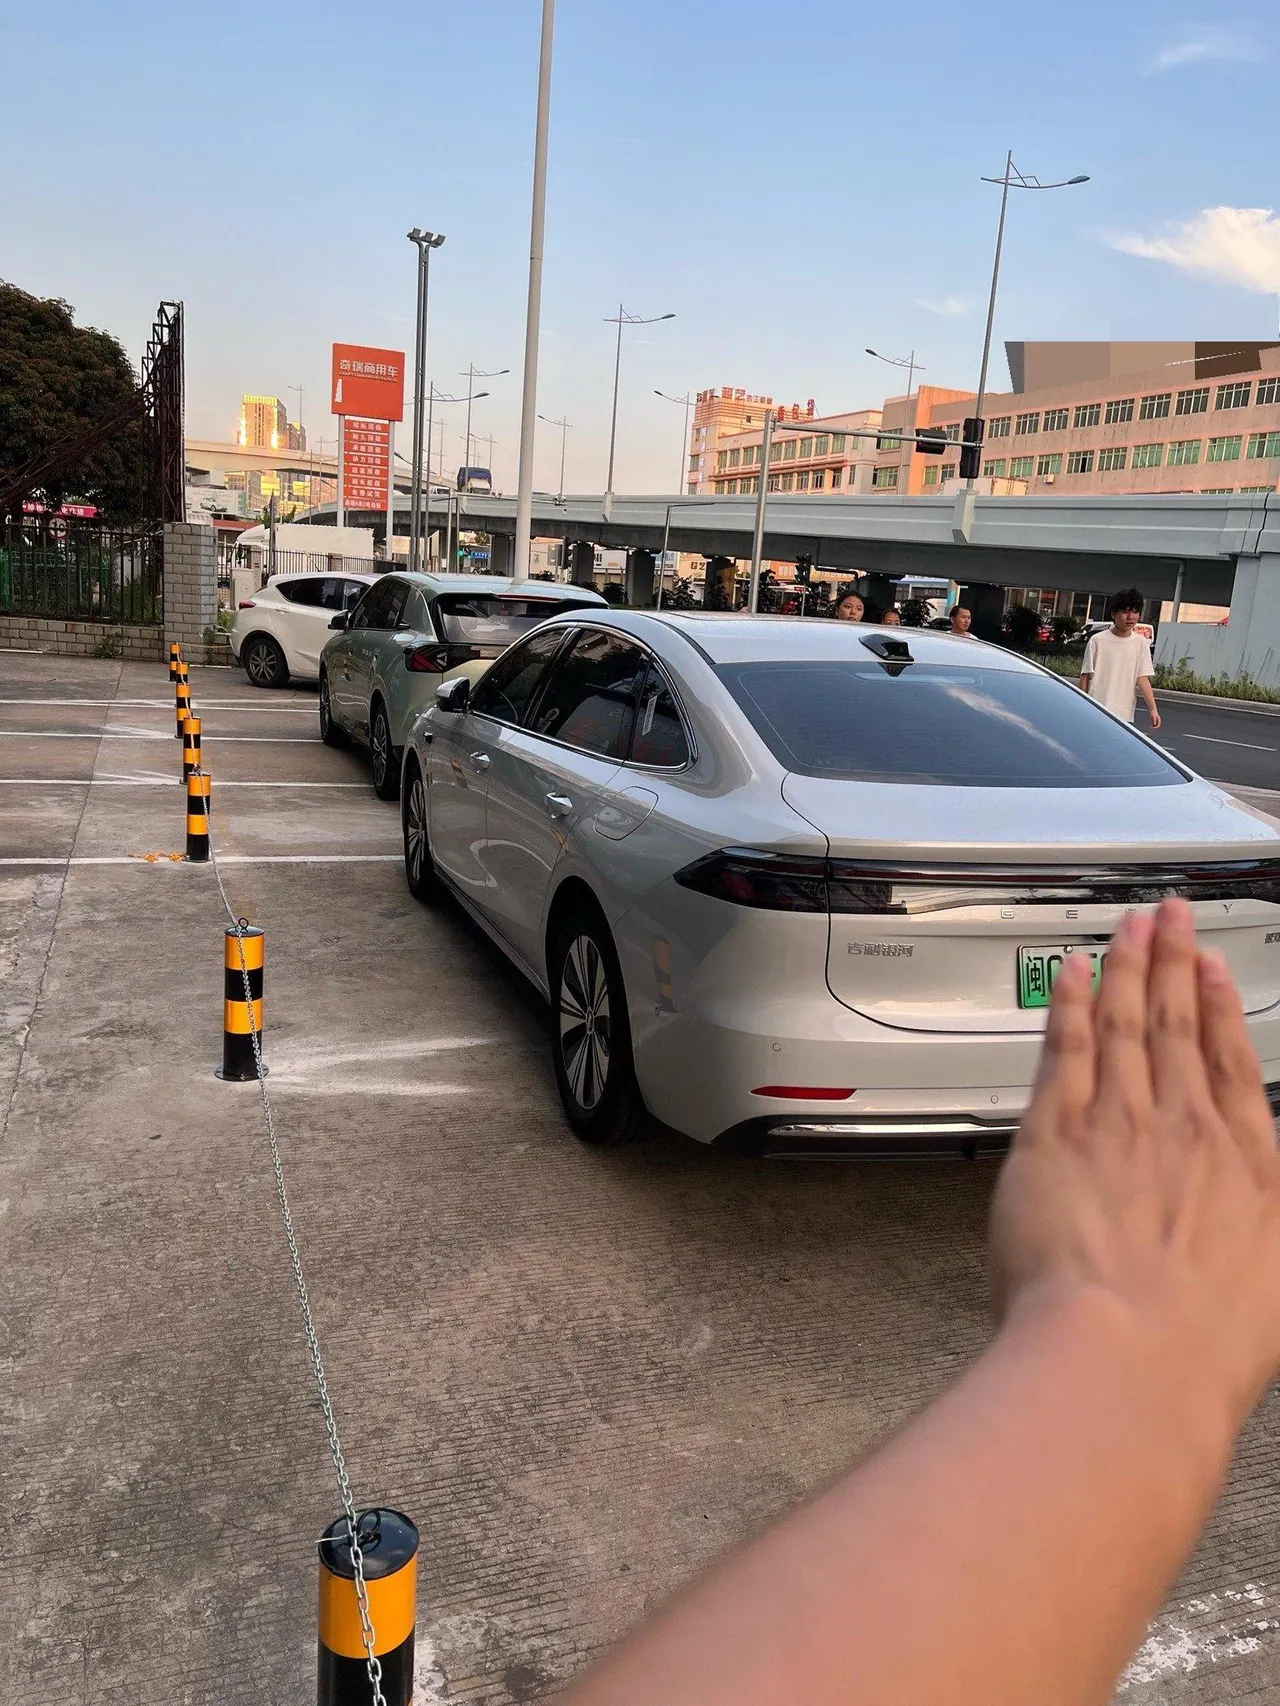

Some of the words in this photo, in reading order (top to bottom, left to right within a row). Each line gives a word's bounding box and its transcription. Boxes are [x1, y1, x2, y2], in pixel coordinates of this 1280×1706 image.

[340, 359, 399, 378] 奇瑞商用车
